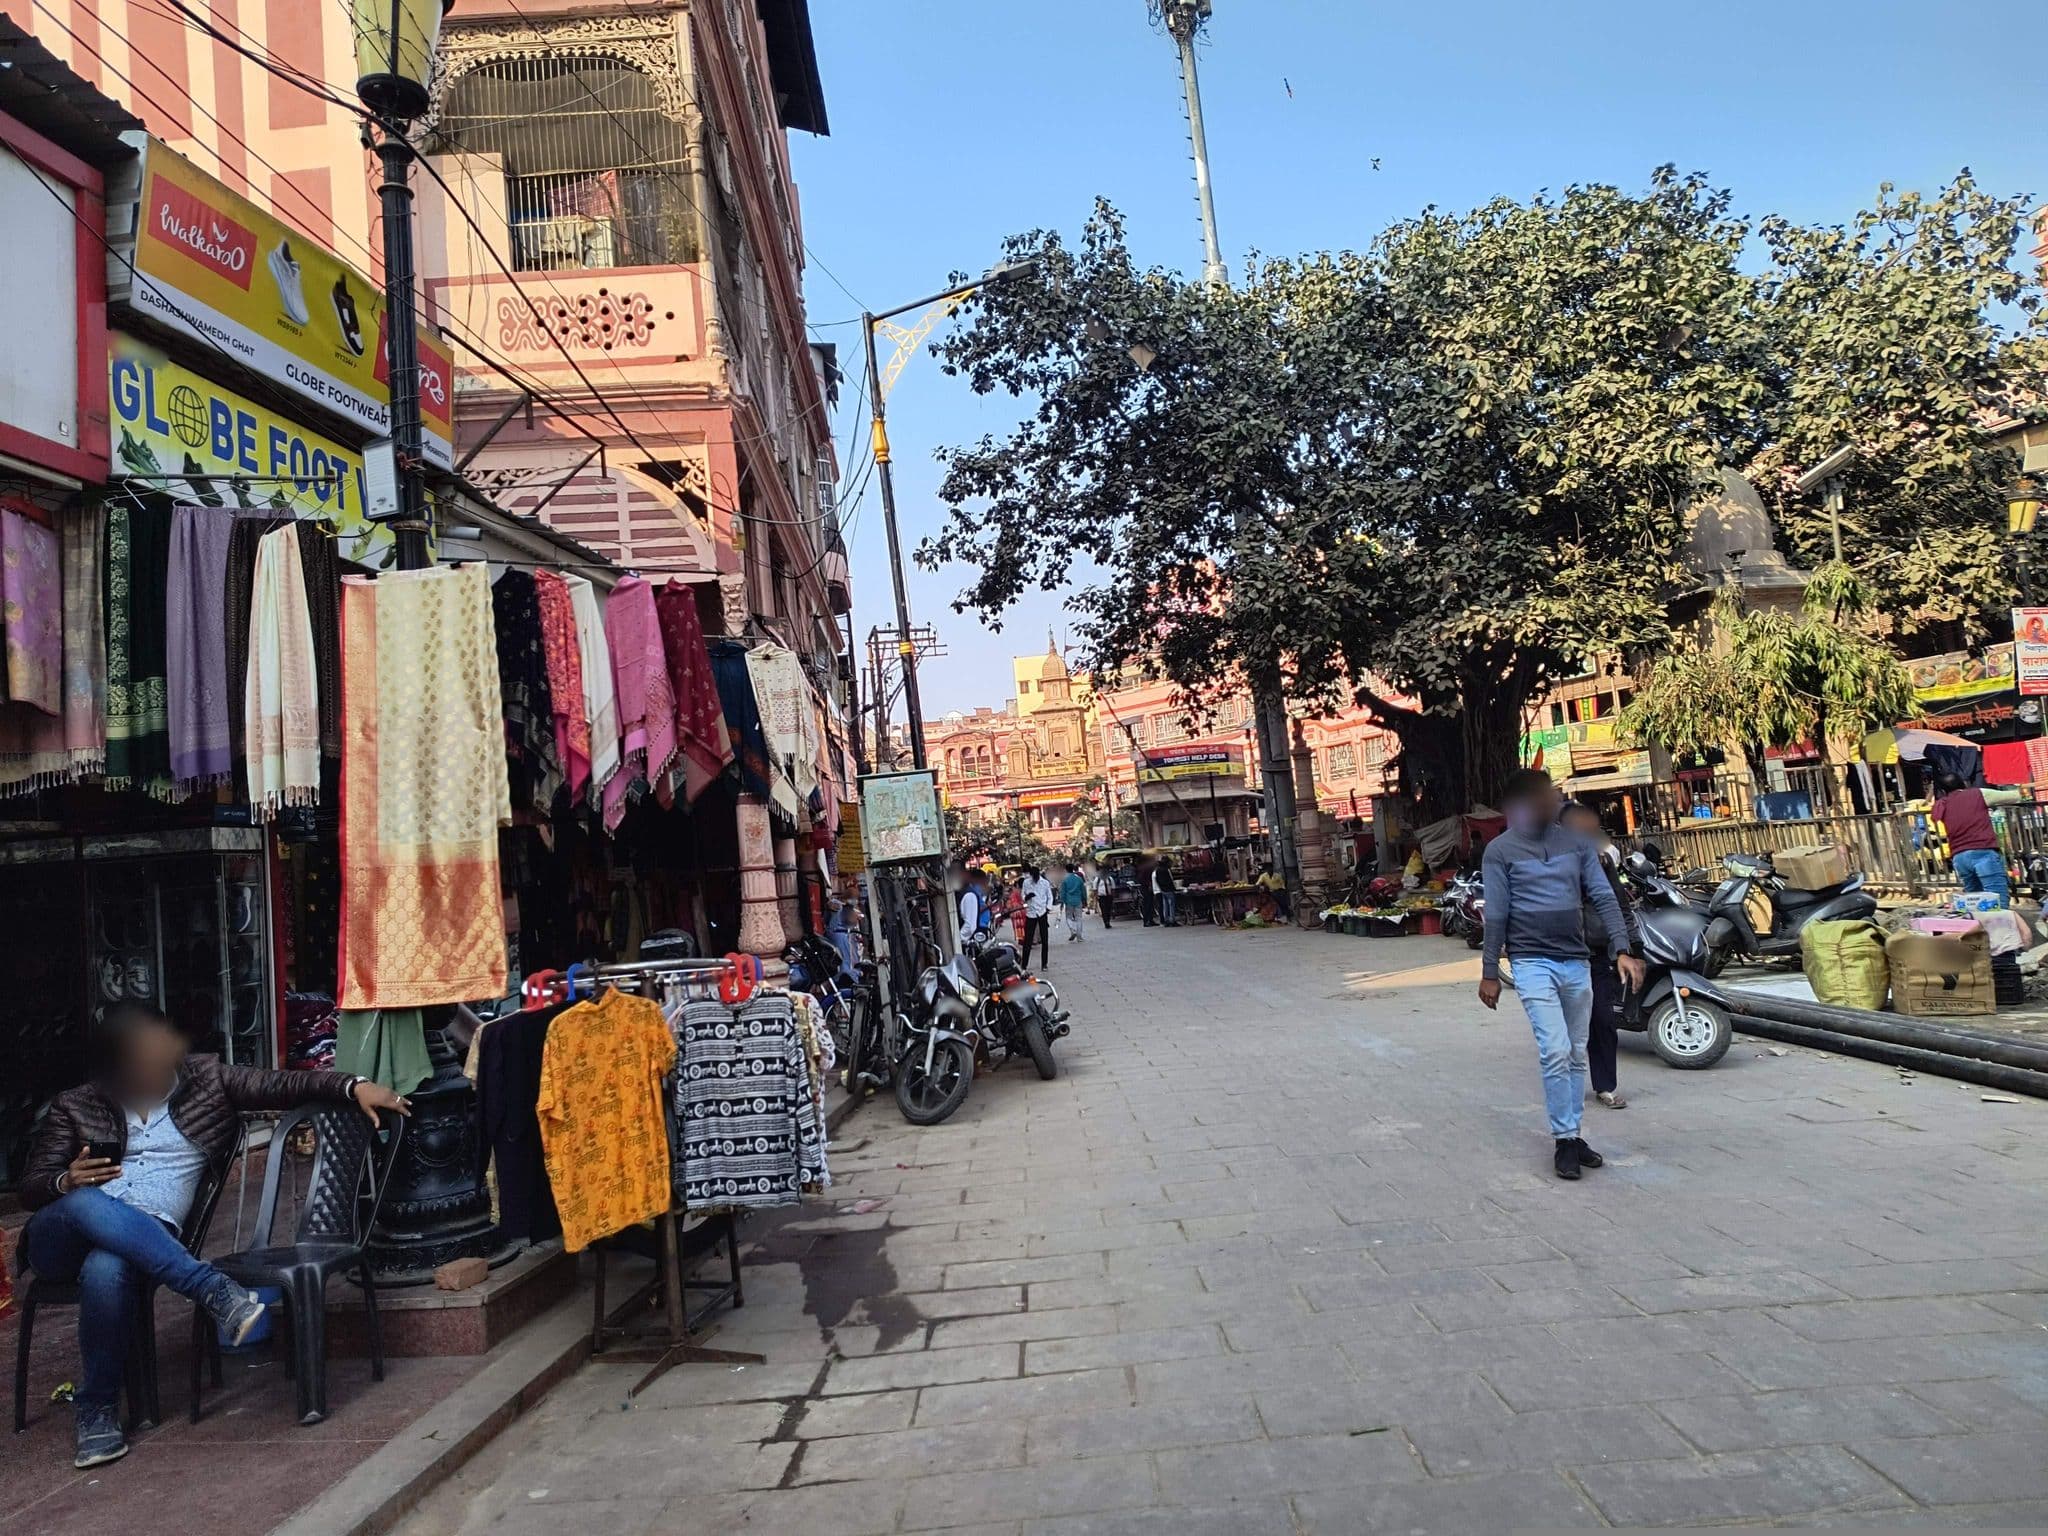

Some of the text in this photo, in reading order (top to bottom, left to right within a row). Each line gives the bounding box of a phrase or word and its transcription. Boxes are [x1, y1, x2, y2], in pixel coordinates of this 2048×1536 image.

[231, 338, 256, 358] GHAT
[285, 363, 389, 429] GLOBE FOOTWEAR
[268, 424, 349, 511] FOOT
[1163, 754, 1191, 764] TOURIST
[1191, 753, 1209, 761] HELP
[1209, 752, 1227, 760] DESK
